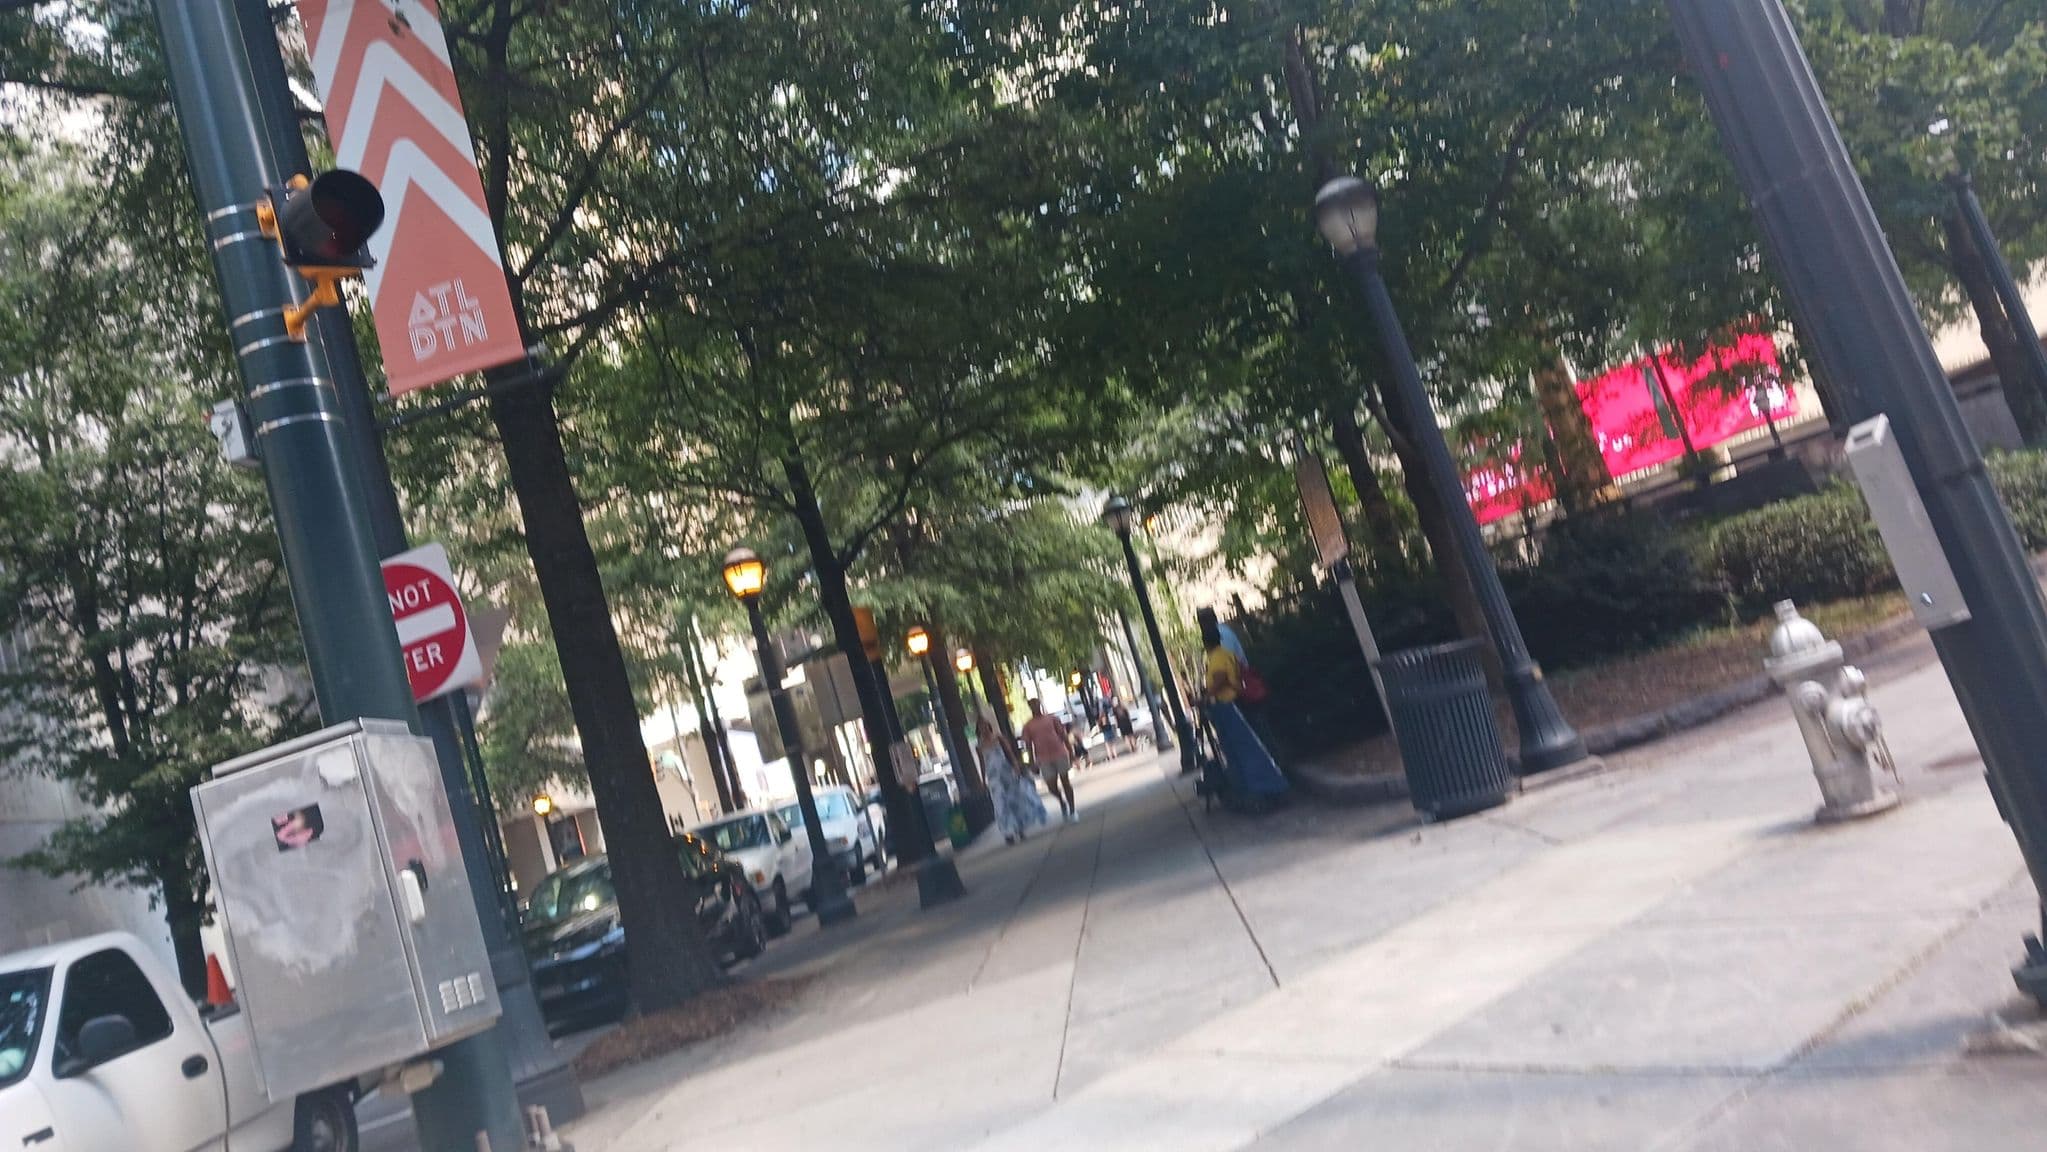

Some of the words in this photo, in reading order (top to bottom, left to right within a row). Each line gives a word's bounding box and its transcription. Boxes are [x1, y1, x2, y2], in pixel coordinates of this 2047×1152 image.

[408, 279, 479, 329] ATL
[409, 313, 488, 362] DTN
[387, 578, 431, 615] NOT
